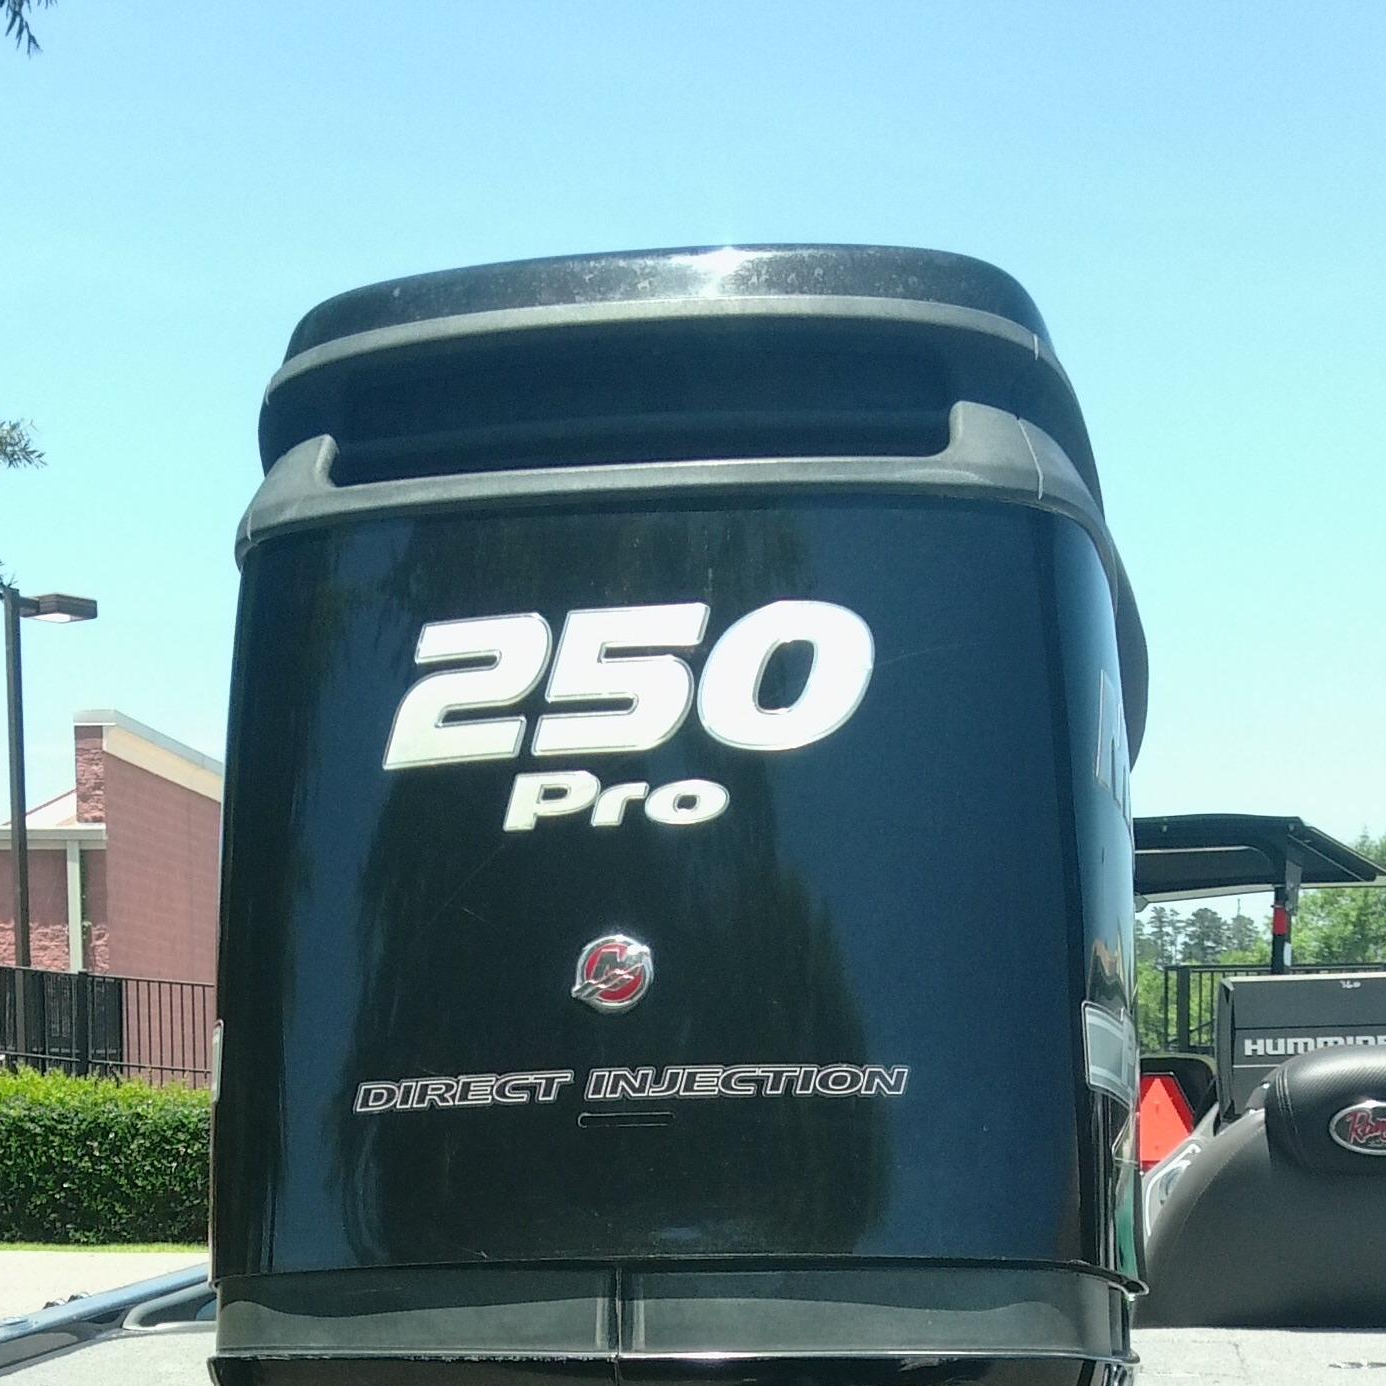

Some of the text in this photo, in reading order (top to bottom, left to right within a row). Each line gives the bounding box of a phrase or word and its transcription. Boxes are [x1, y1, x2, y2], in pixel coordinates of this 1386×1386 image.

[382, 600, 875, 770] 250
[503, 770, 730, 831] Pro
[353, 1064, 909, 1114] DIRECT INJECTION
